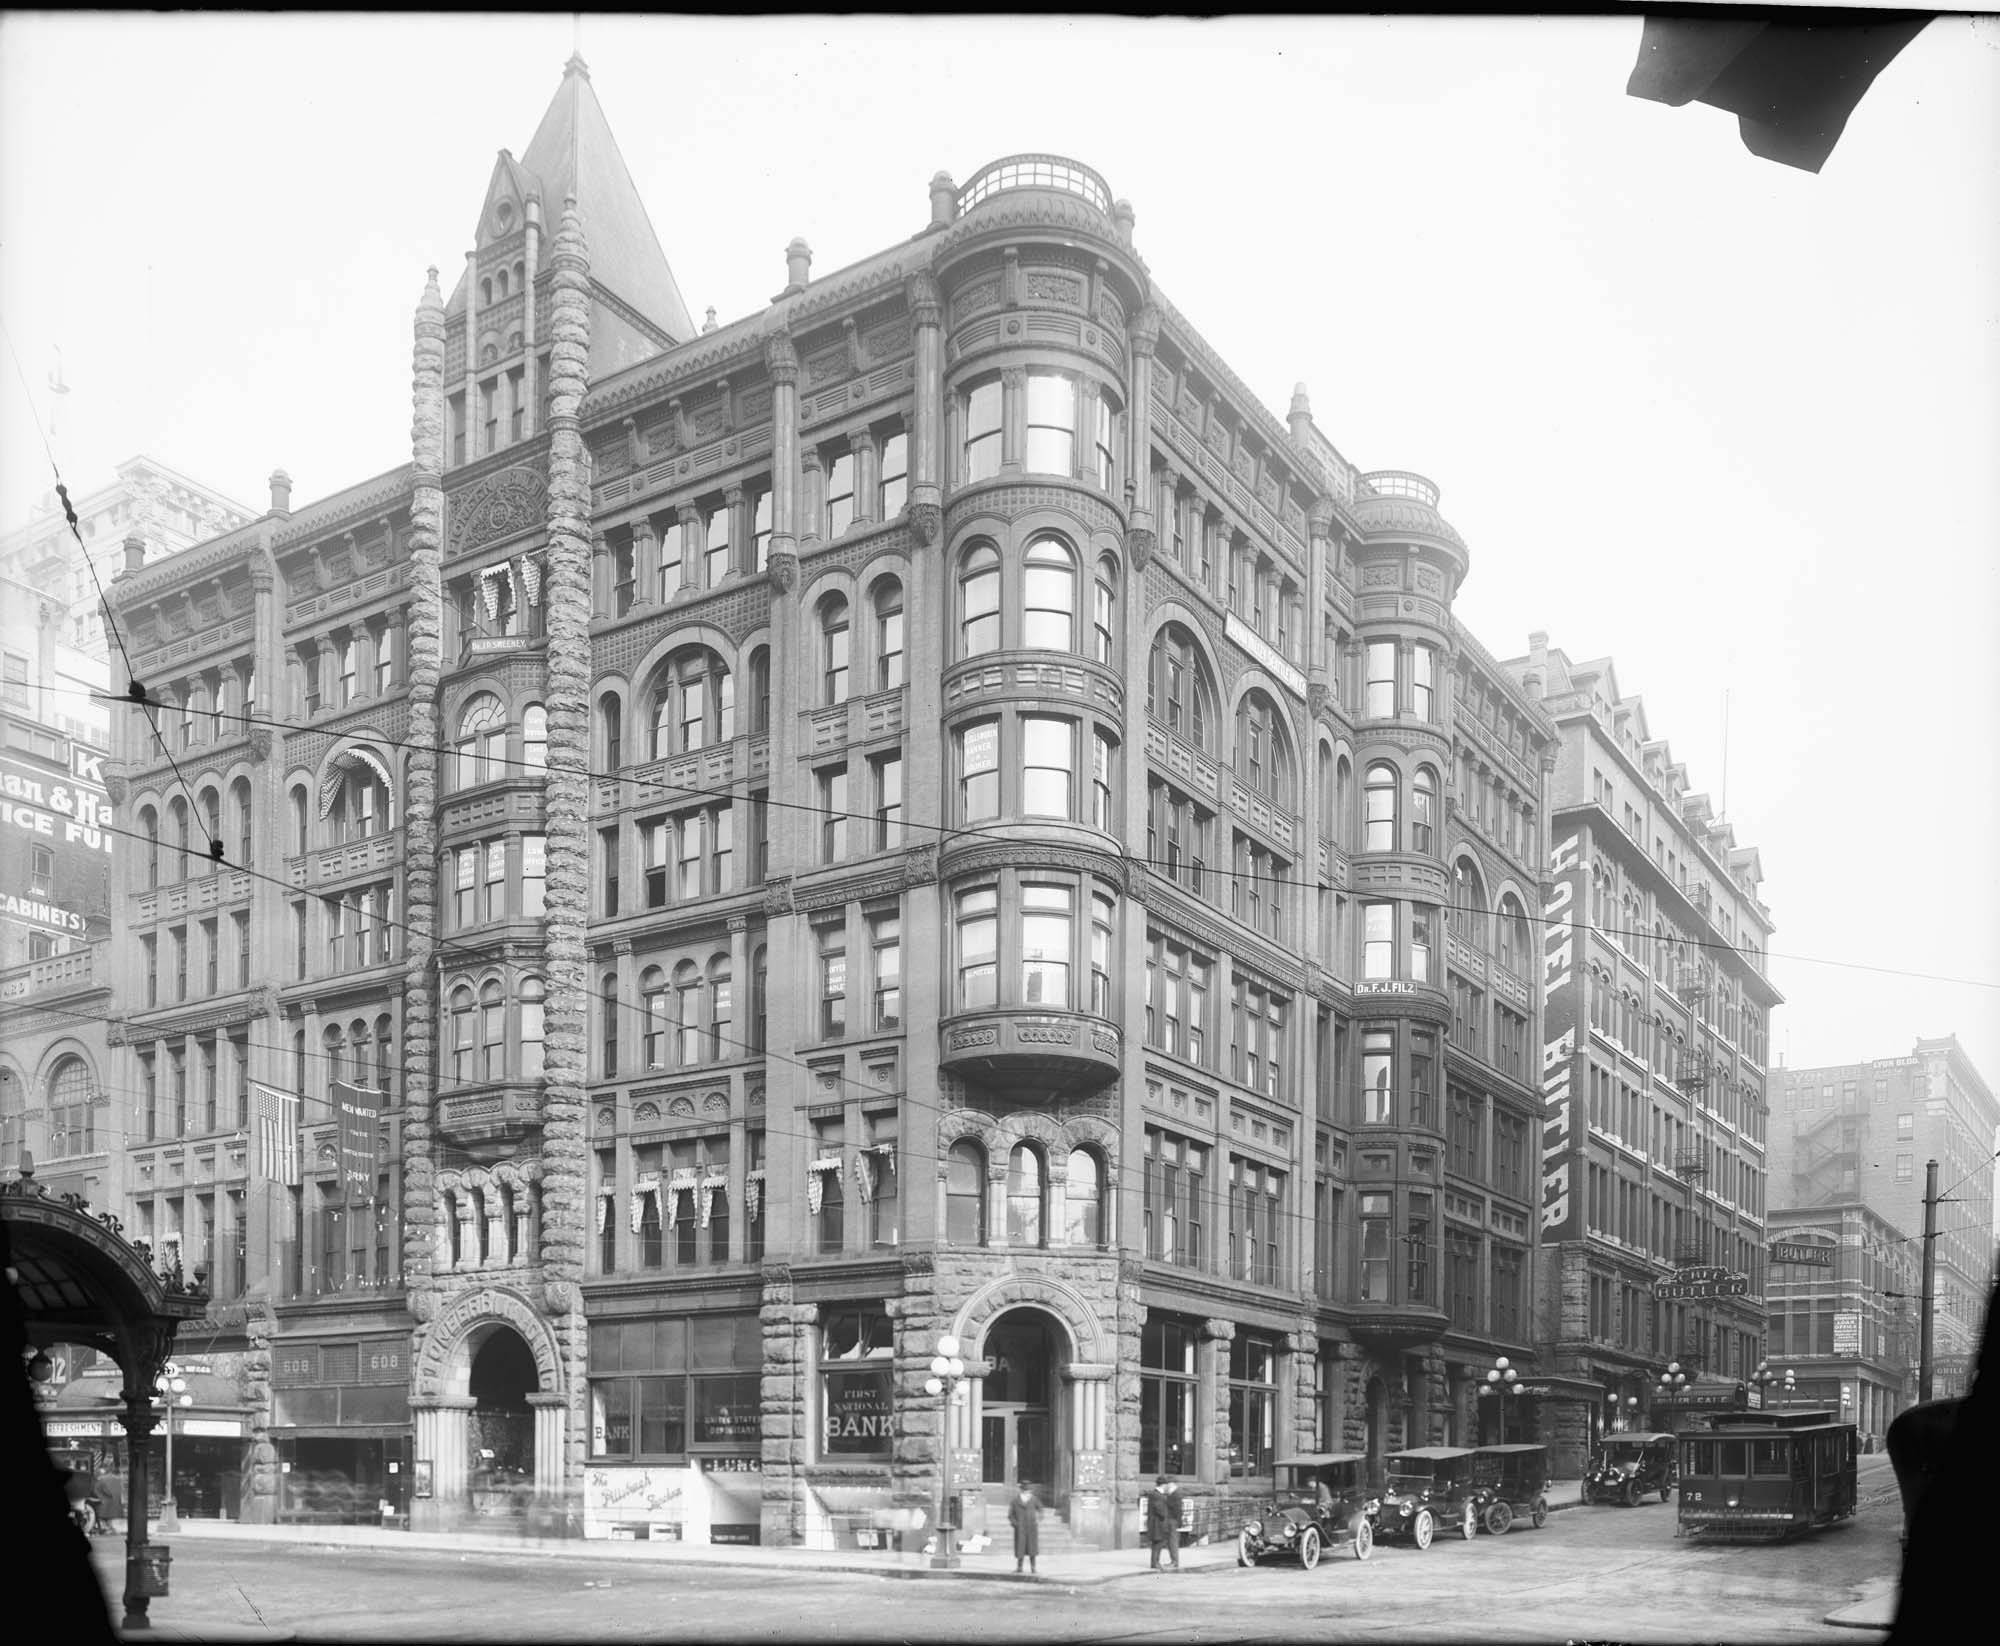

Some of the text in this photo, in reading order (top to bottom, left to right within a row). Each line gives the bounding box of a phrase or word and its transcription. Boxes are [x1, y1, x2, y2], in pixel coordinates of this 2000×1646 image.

[0, 771, 44, 803] an
[49, 786, 73, 815] &
[0, 802, 54, 837] ICE
[1544, 834, 1578, 1007] HOTEL
[1392, 982, 1414, 993] FILZ
[1541, 1026, 1576, 1234] BUTLER
[1780, 1246, 1832, 1264] BUTLER
[1657, 1282, 1743, 1298] BUTLER
[284, 1360, 309, 1373] 608
[371, 1355, 398, 1369] 608
[844, 1389, 878, 1400] FIRST
[833, 1402, 889, 1411] NATIONAL
[594, 1425, 630, 1440] BANK
[828, 1415, 895, 1437] BANK
[1686, 1492, 1702, 1501] 72
